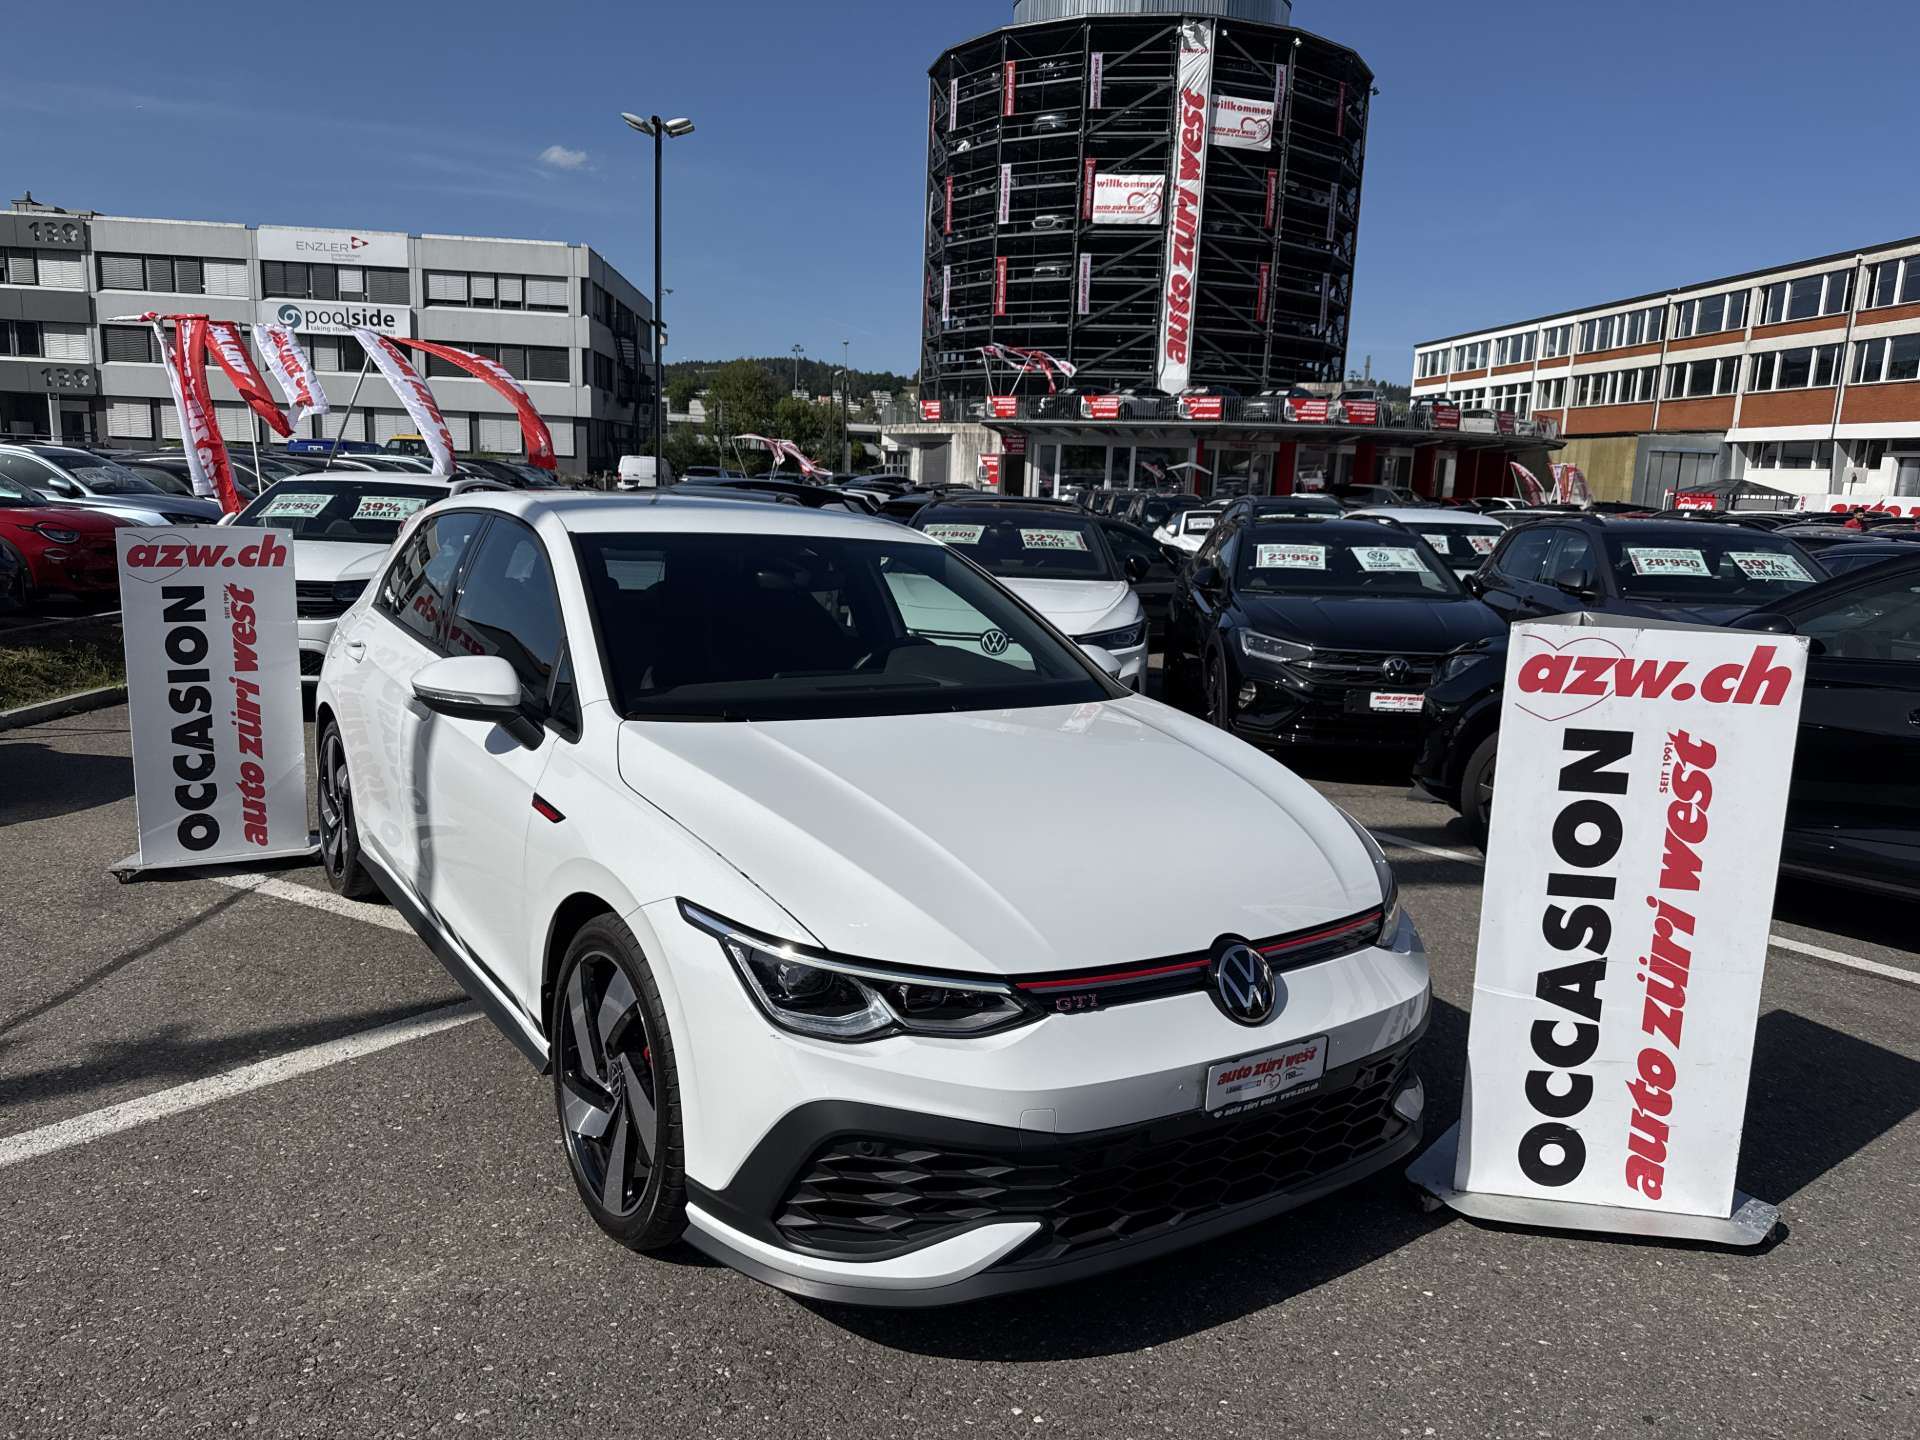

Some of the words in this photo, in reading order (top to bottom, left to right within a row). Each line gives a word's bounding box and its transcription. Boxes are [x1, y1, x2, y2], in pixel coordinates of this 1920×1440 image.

[1213, 99, 1272, 115] willkommen
[296, 240, 349, 253] ENZLER
[305, 307, 396, 330] poolside
[1167, 274, 1192, 365] auto
[273, 502, 321, 511] 28'950
[361, 502, 401, 512] 39%
[126, 535, 287, 568] azw.ch
[1024, 534, 1064, 543] 32%
[1268, 553, 1319, 562] 23'950
[1644, 558, 1701, 568] 28'950
[1738, 559, 1785, 571] 39%
[1749, 570, 1791, 578] RABATT
[224, 583, 257, 672] west
[1517, 645, 1792, 706] azw.ch
[161, 585, 221, 851] OCCASION
[228, 675, 265, 760] züri
[1663, 741, 1674, 767] 1991
[1659, 770, 1671, 794] SEIT
[235, 761, 269, 847] auto
[1658, 729, 1718, 892] west
[1518, 728, 1635, 1188] OCCASION
[1636, 895, 1697, 1050] züri
[1056, 993, 1099, 1011] GTI
[1217, 1065, 1253, 1086] auto
[1252, 1054, 1286, 1077] züri
[1285, 1046, 1318, 1067] west
[1625, 1047, 1678, 1201] auto
